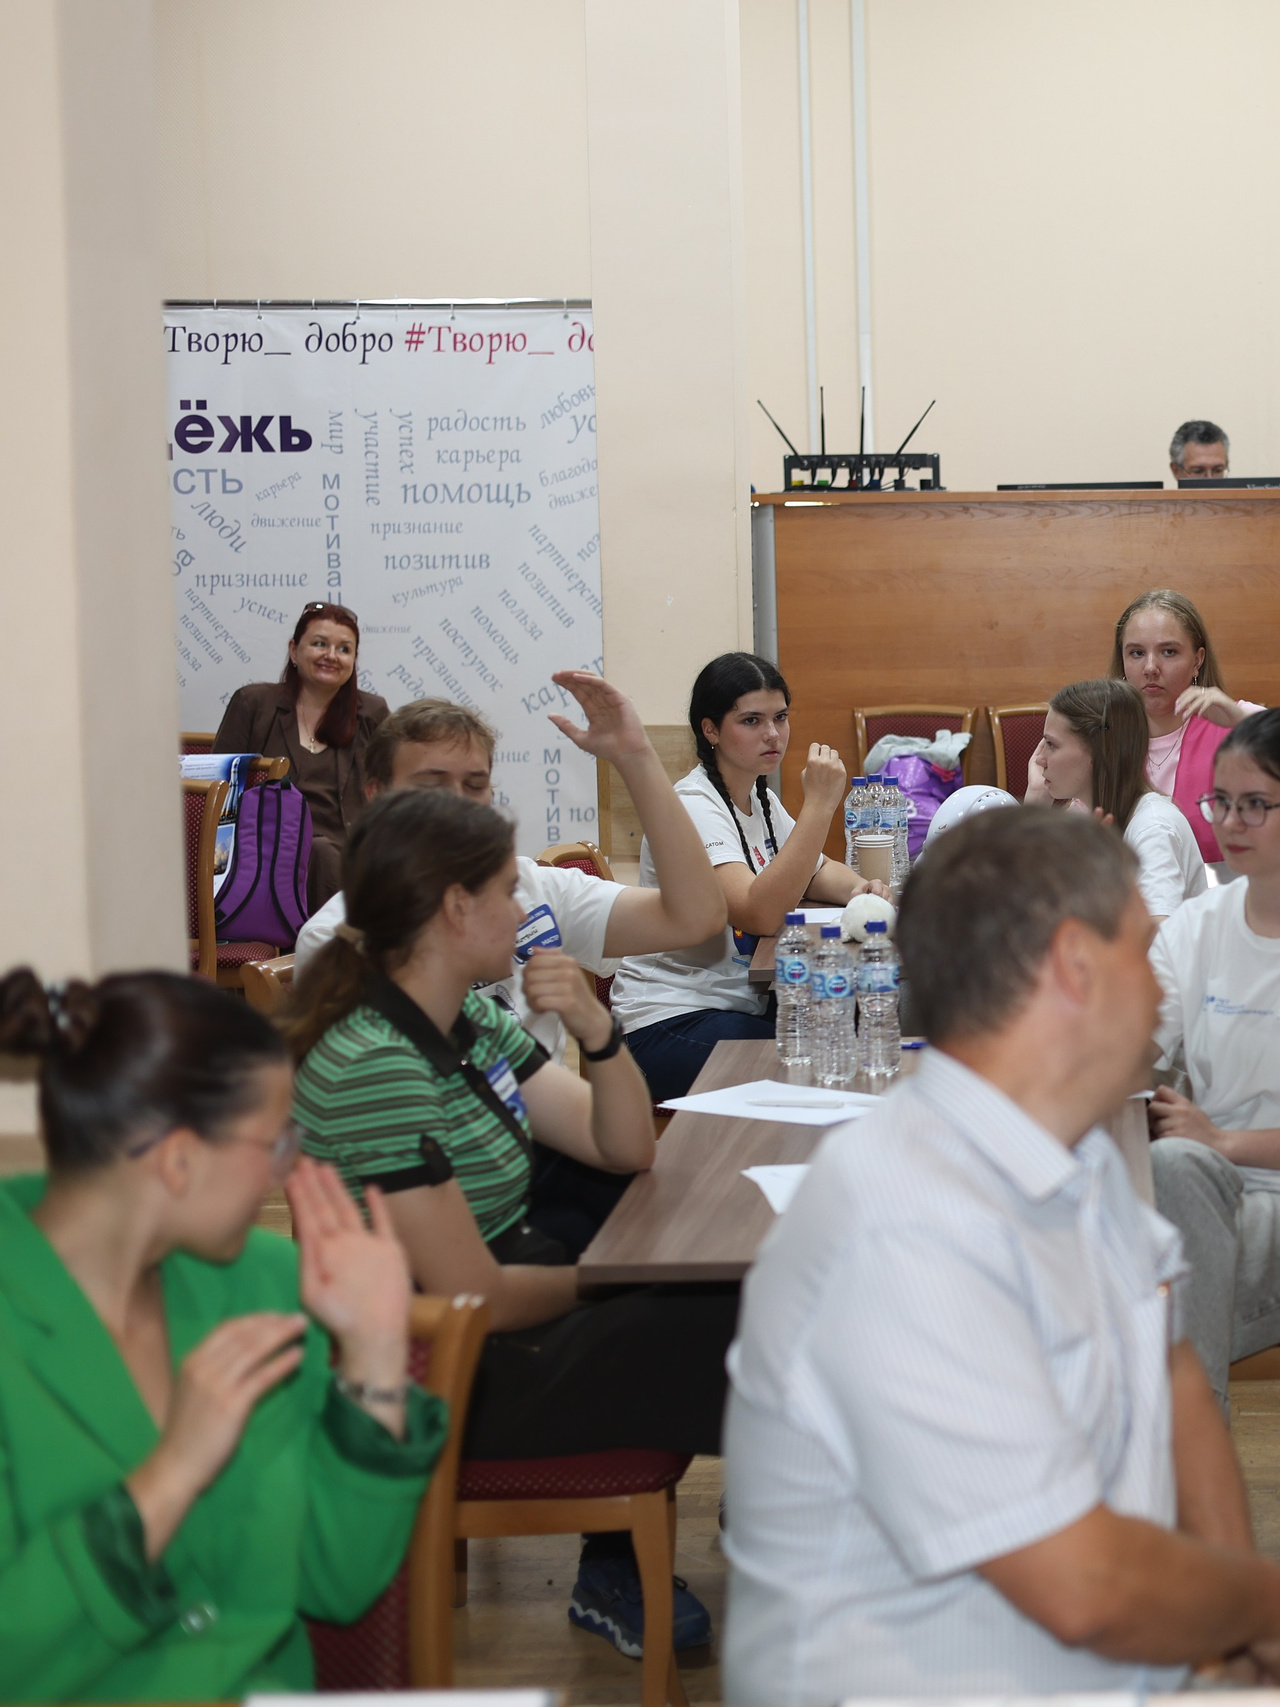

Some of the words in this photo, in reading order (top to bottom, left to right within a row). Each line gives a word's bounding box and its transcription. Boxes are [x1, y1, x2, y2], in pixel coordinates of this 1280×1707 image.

[305, 322, 393, 365] добро
[405, 322, 554, 365] #Творю_
[167, 400, 312, 460] ёжь
[321, 410, 344, 455] мир
[389, 408, 414, 474] успех
[427, 409, 526, 440] радость
[354, 408, 380, 507] участие
[436, 448, 522, 472] карьера
[255, 472, 302, 501] карьера
[400, 483, 531, 508] помощь
[190, 501, 247, 553] люди
[251, 514, 321, 528] движение
[371, 521, 464, 541] признание
[384, 553, 491, 571] позитив
[194, 572, 308, 595] признание
[392, 576, 464, 608] культура
[517, 561, 575, 629] позитив
[184, 588, 251, 664] партнерство
[233, 597, 289, 625] успех
[498, 589, 543, 641] польза
[174, 636, 202, 672] ольза
[179, 614, 224, 665] позитив
[470, 606, 520, 665] помощь
[439, 618, 503, 693] поступок
[704, 841, 724, 849] САТОМ
